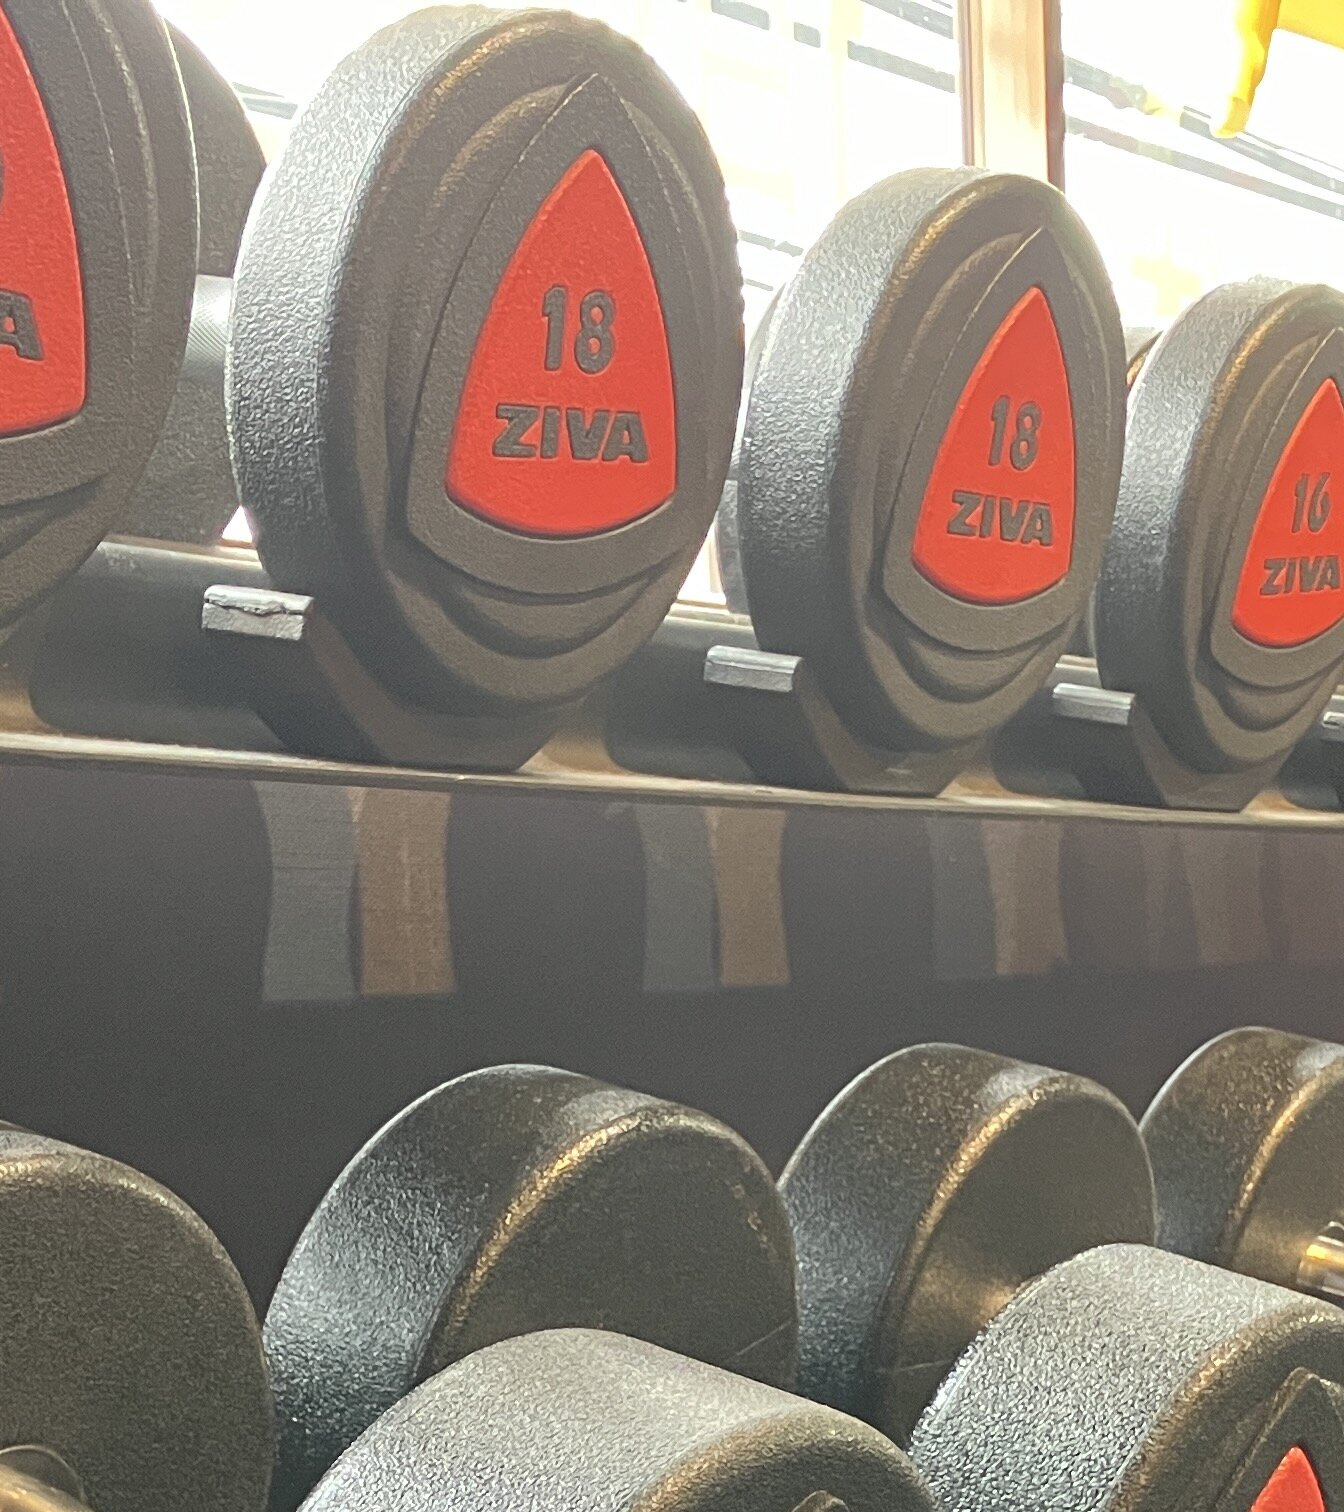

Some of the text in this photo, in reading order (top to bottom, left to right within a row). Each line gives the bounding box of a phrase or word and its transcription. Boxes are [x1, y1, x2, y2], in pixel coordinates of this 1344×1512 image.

[541, 284, 616, 375] 18
[491, 403, 650, 464] ZIVA
[988, 395, 1042, 472] 18
[946, 490, 1054, 548] ZIVA
[1290, 471, 1332, 535] 16
[1258, 554, 1343, 597] ZIVA
